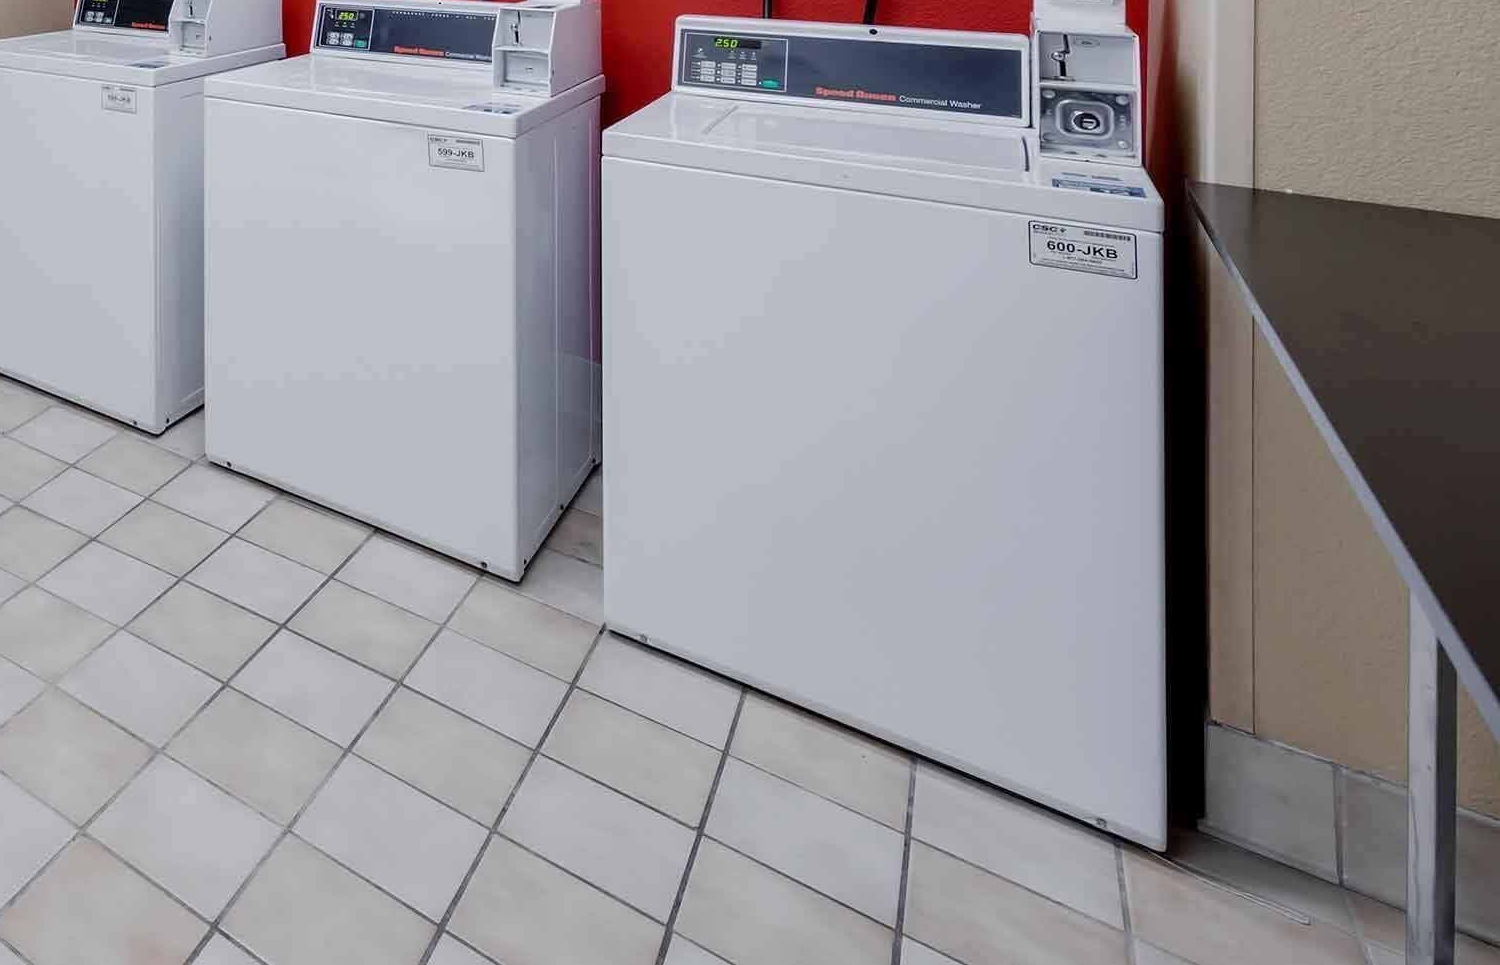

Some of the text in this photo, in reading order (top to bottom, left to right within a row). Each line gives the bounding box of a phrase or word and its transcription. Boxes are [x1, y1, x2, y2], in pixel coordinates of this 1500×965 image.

[715, 38, 739, 49] 250
[815, 86, 981, 110] Speed Queen Commercial Washer
[437, 147, 475, 158] 599-JKB
[1032, 224, 1058, 233] CSC
[1047, 240, 1118, 259] 600-JKB
